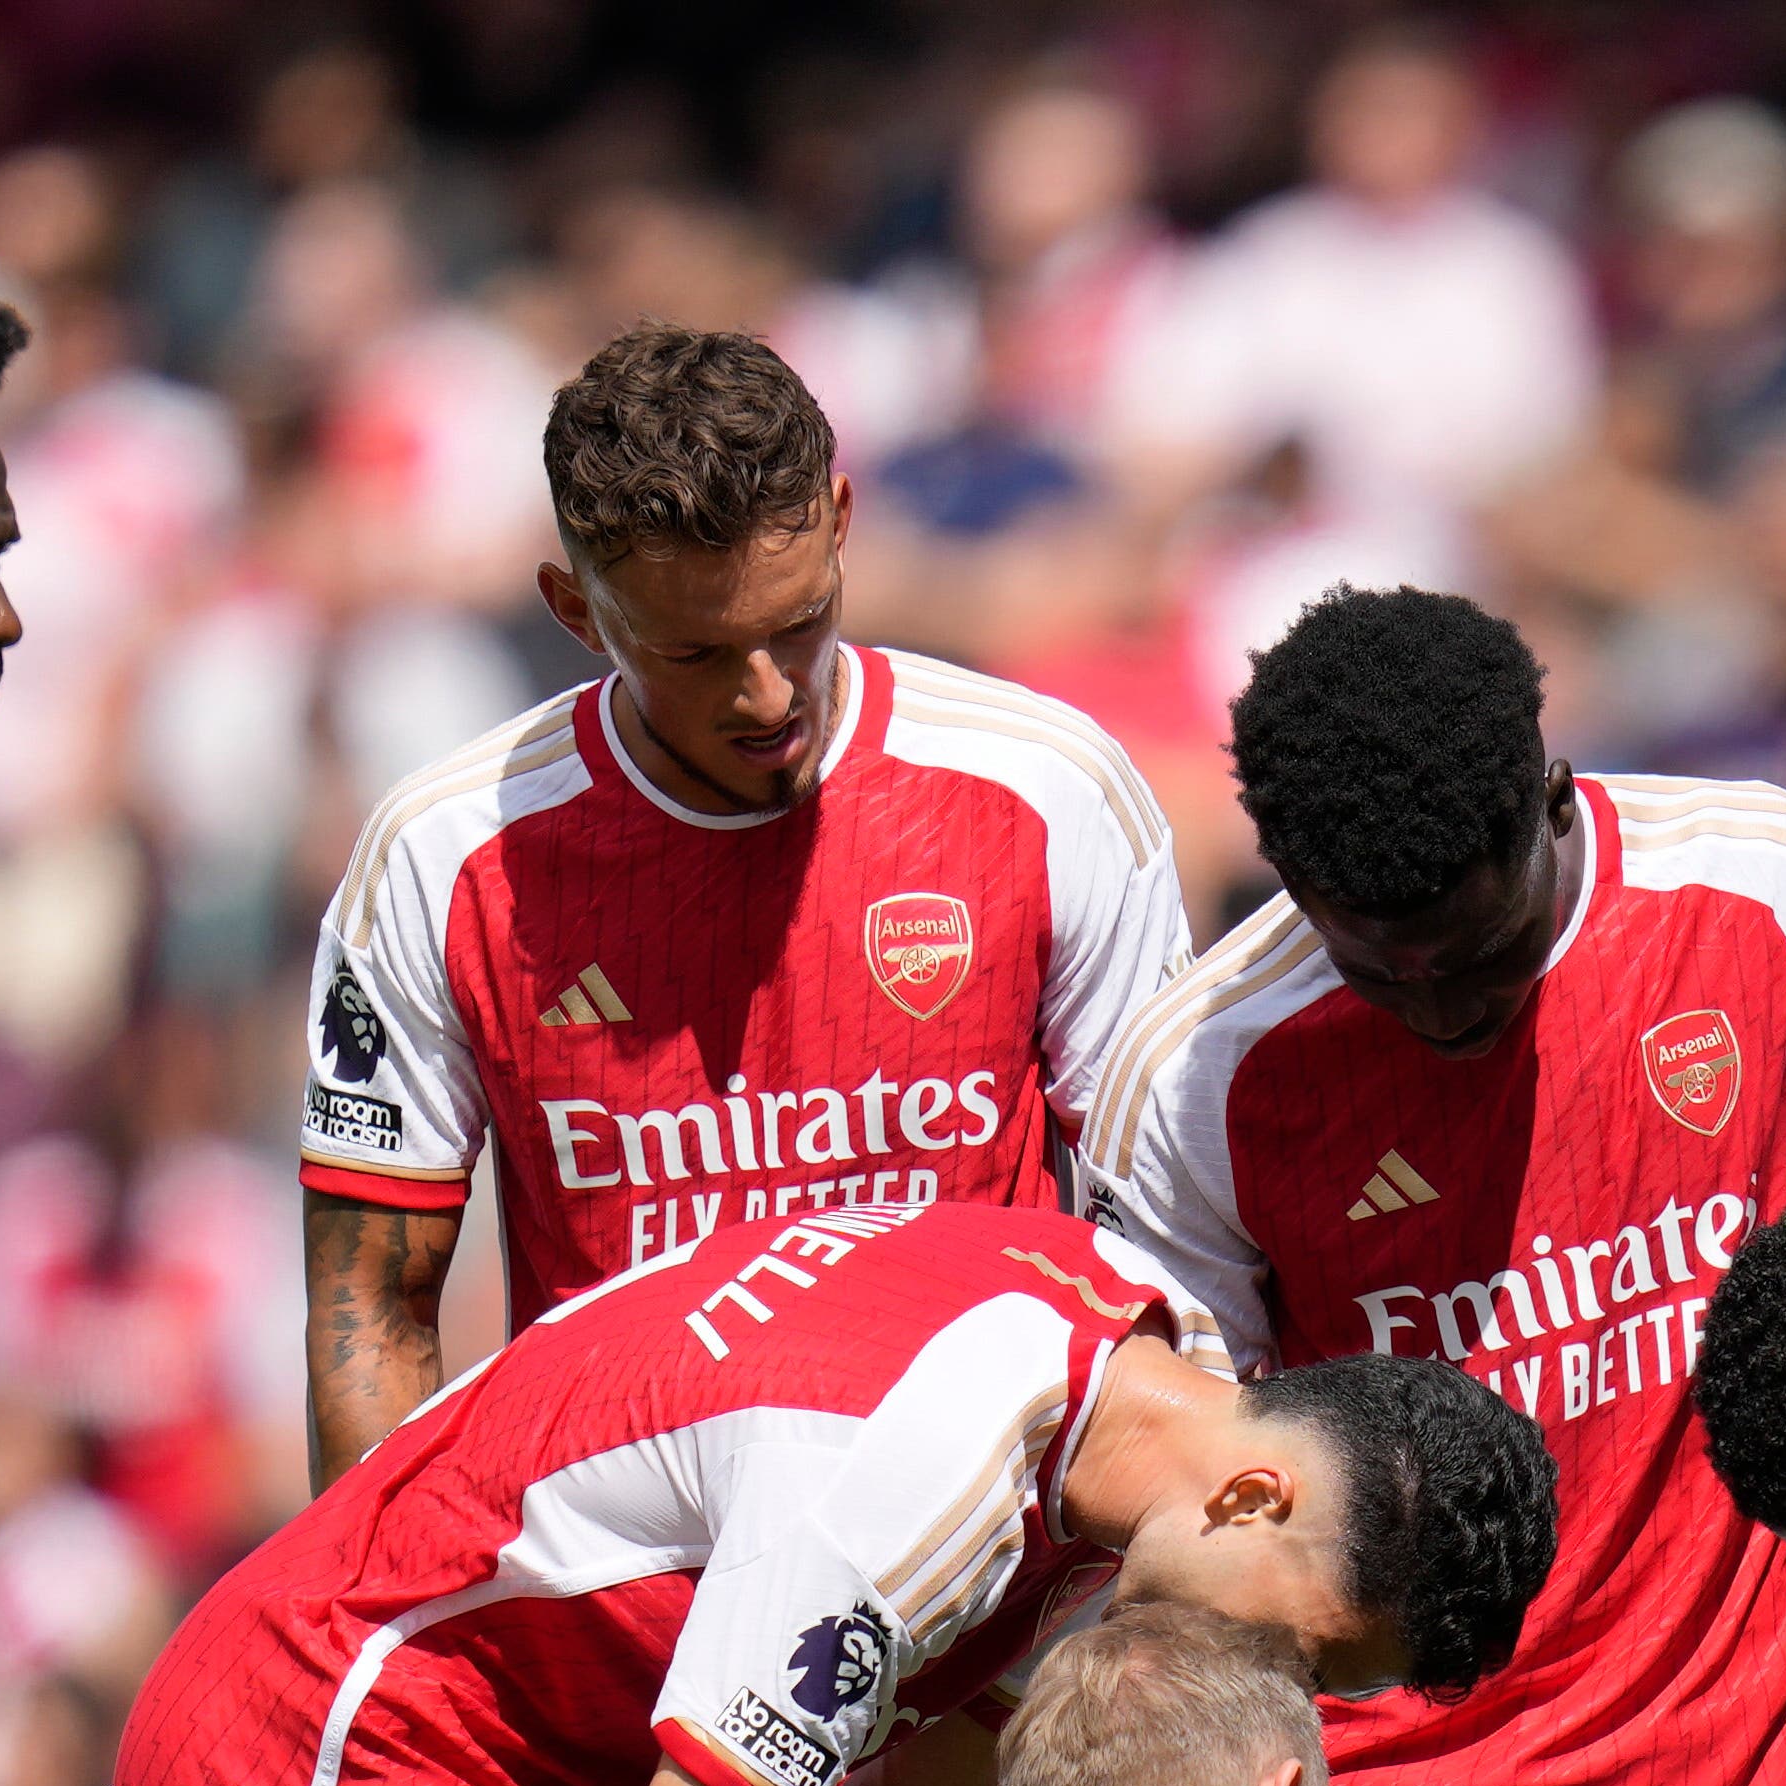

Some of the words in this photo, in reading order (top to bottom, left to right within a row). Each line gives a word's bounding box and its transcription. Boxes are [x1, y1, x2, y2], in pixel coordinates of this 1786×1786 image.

[880, 912, 958, 939] Arsenal
[1657, 1025, 1725, 1066] Arsenal
[329, 1094, 392, 1128] room
[539, 1070, 1001, 1190] Emirates
[327, 1116, 402, 1152] racism
[1560, 1296, 1708, 1421] BETTE
[715, 1706, 757, 1744] for
[728, 1687, 769, 1728] No
[764, 1719, 826, 1773] room
